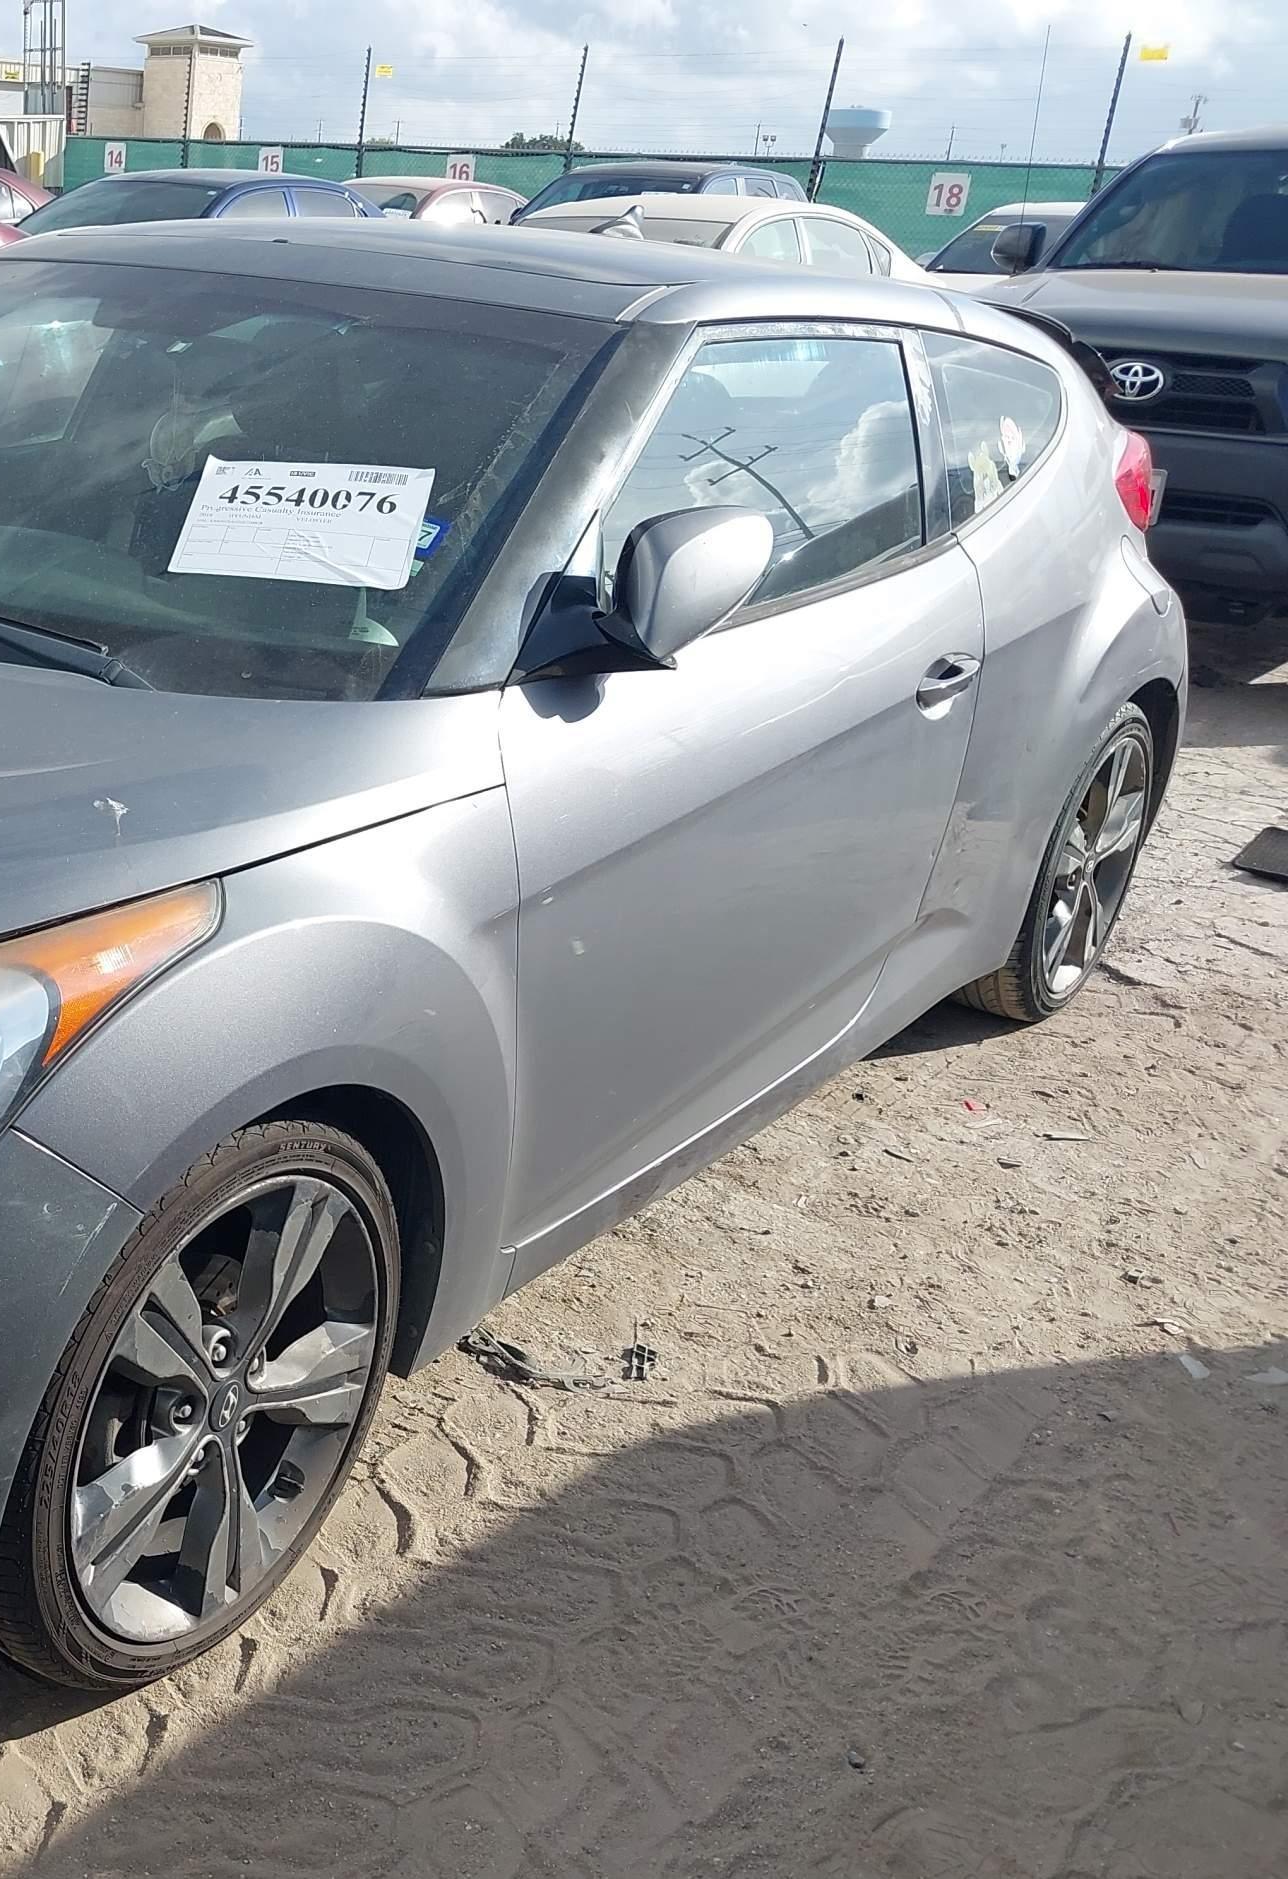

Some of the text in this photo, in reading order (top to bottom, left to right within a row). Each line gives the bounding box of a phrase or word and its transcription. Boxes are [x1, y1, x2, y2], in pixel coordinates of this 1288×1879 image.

[107, 150, 123, 167] 14
[262, 154, 280, 172] 15
[449, 163, 470, 181] 16
[933, 183, 963, 208] 18
[218, 484, 400, 515] 45540076
[254, 506, 294, 515] Casualty
[297, 508, 342, 518] Insurance
[279, 1141, 327, 1151] SENTURY
